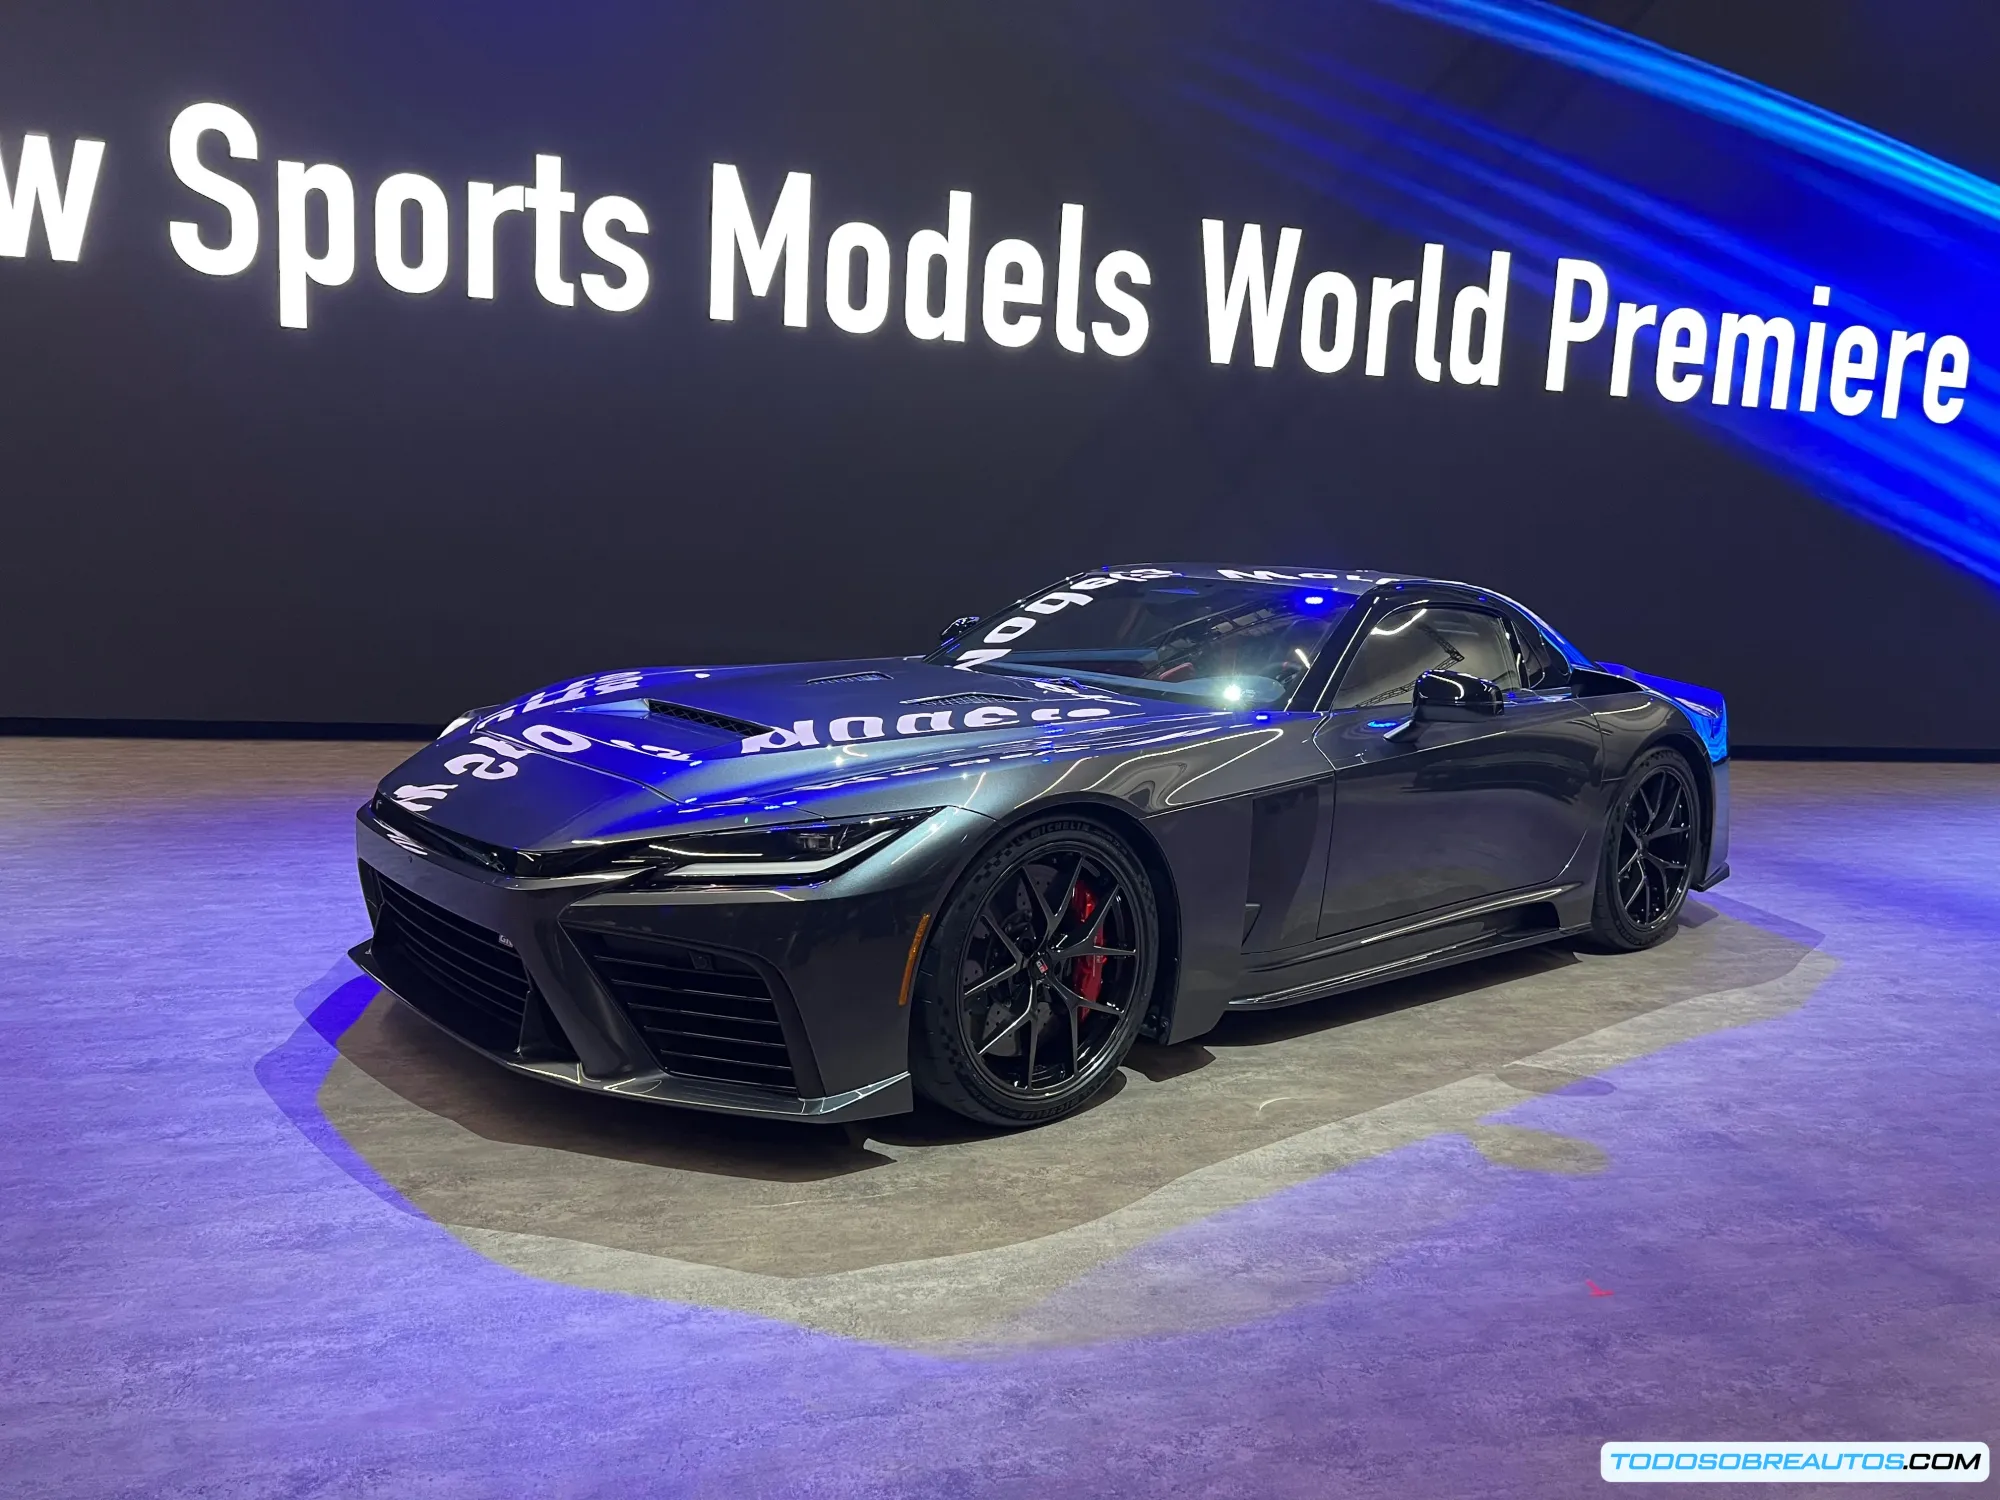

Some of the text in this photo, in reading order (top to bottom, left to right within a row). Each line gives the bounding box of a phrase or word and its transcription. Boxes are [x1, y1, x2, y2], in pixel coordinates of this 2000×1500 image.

[169, 102, 650, 329] Sports
[709, 162, 1152, 357] Models
[1201, 218, 1511, 387] World
[1545, 257, 1970, 424] Premiere
[1030, 820, 1091, 838] MICHELIN
